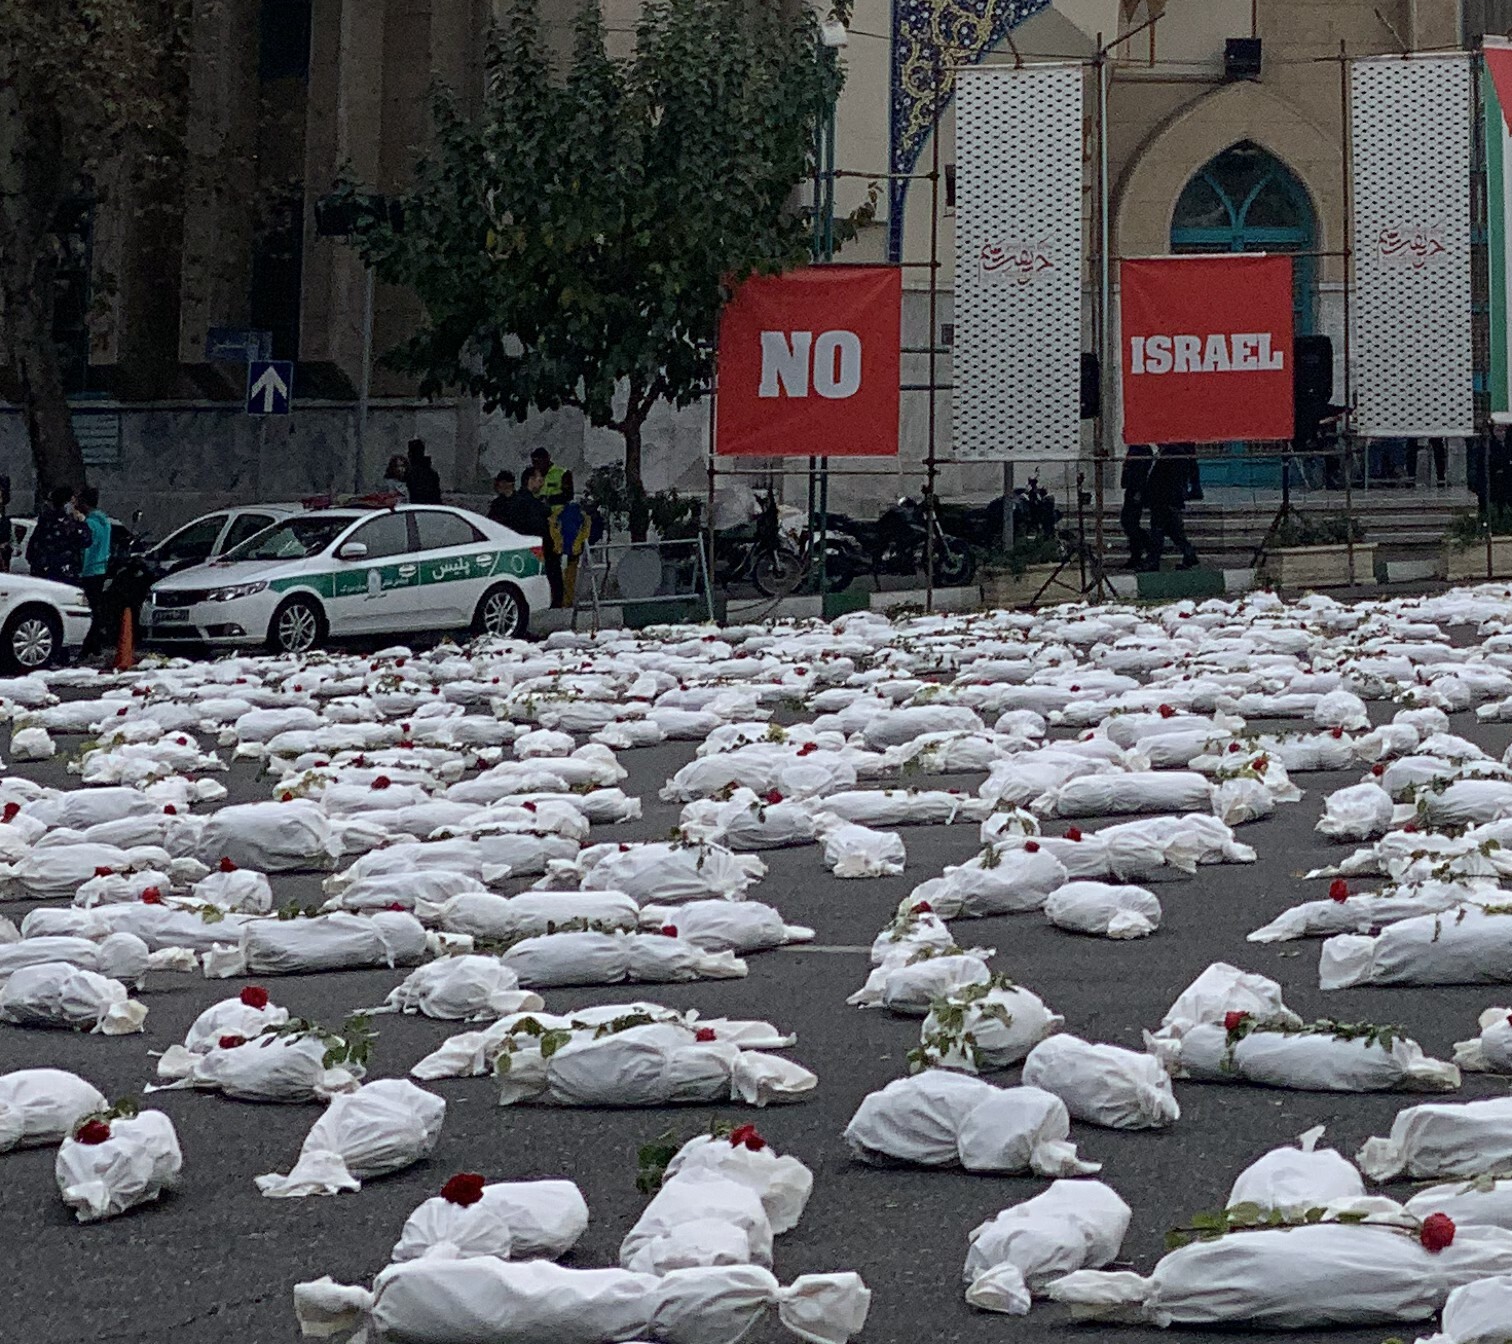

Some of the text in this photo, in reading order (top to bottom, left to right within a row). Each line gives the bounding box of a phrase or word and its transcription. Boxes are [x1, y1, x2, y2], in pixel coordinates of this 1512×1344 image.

[759, 331, 861, 398] NO
[1131, 334, 1283, 373] ISRAEL
[432, 557, 470, 580] پلیس
